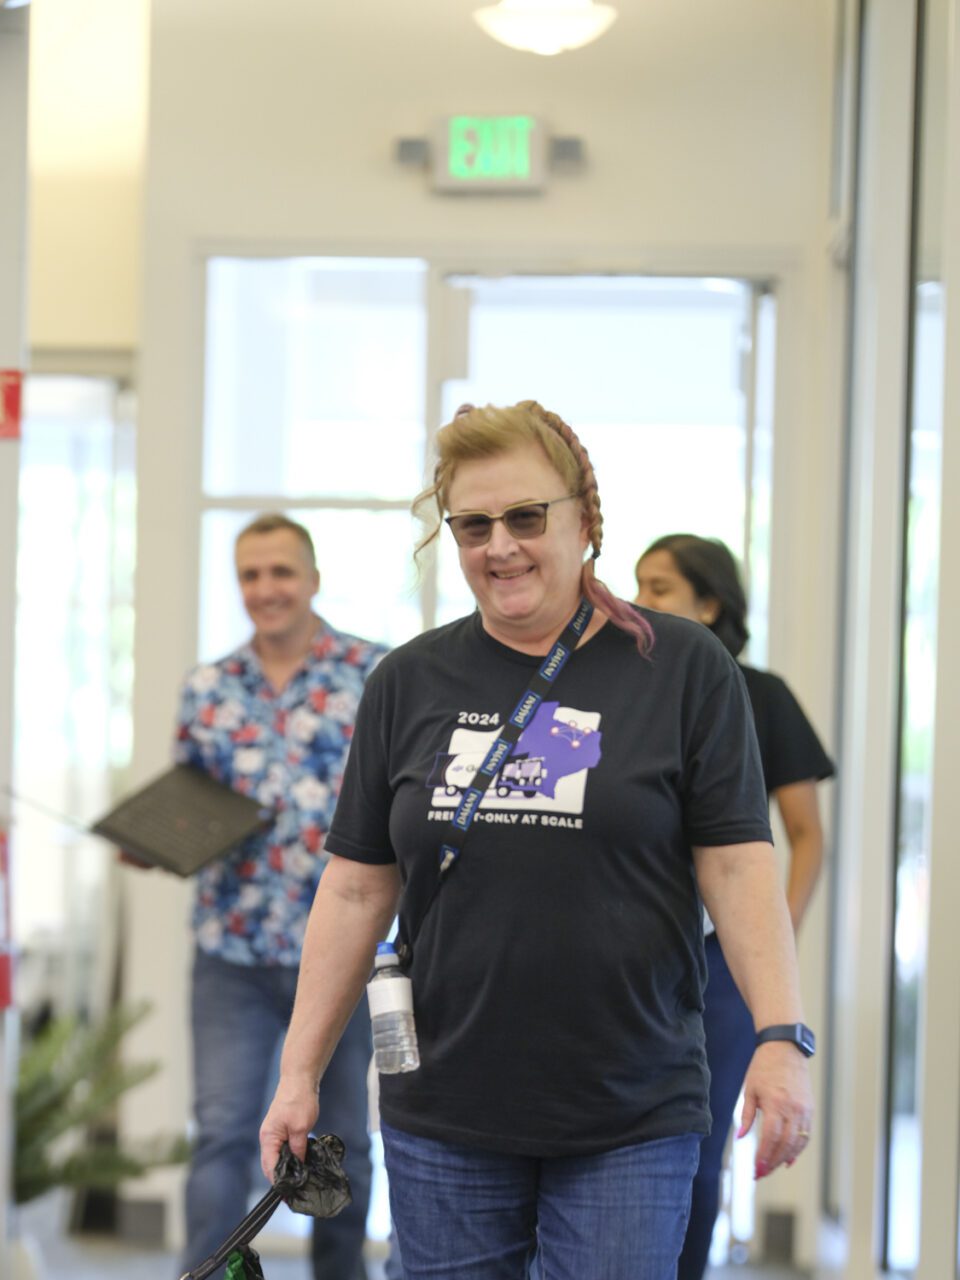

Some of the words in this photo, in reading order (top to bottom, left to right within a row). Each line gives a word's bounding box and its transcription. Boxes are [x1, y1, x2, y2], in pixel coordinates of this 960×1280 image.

[457, 711, 500, 726] 2024
[427, 811, 519, 824] FREIT-ONLY
[521, 814, 538, 825] AT
[541, 815, 583, 829] SCALE
